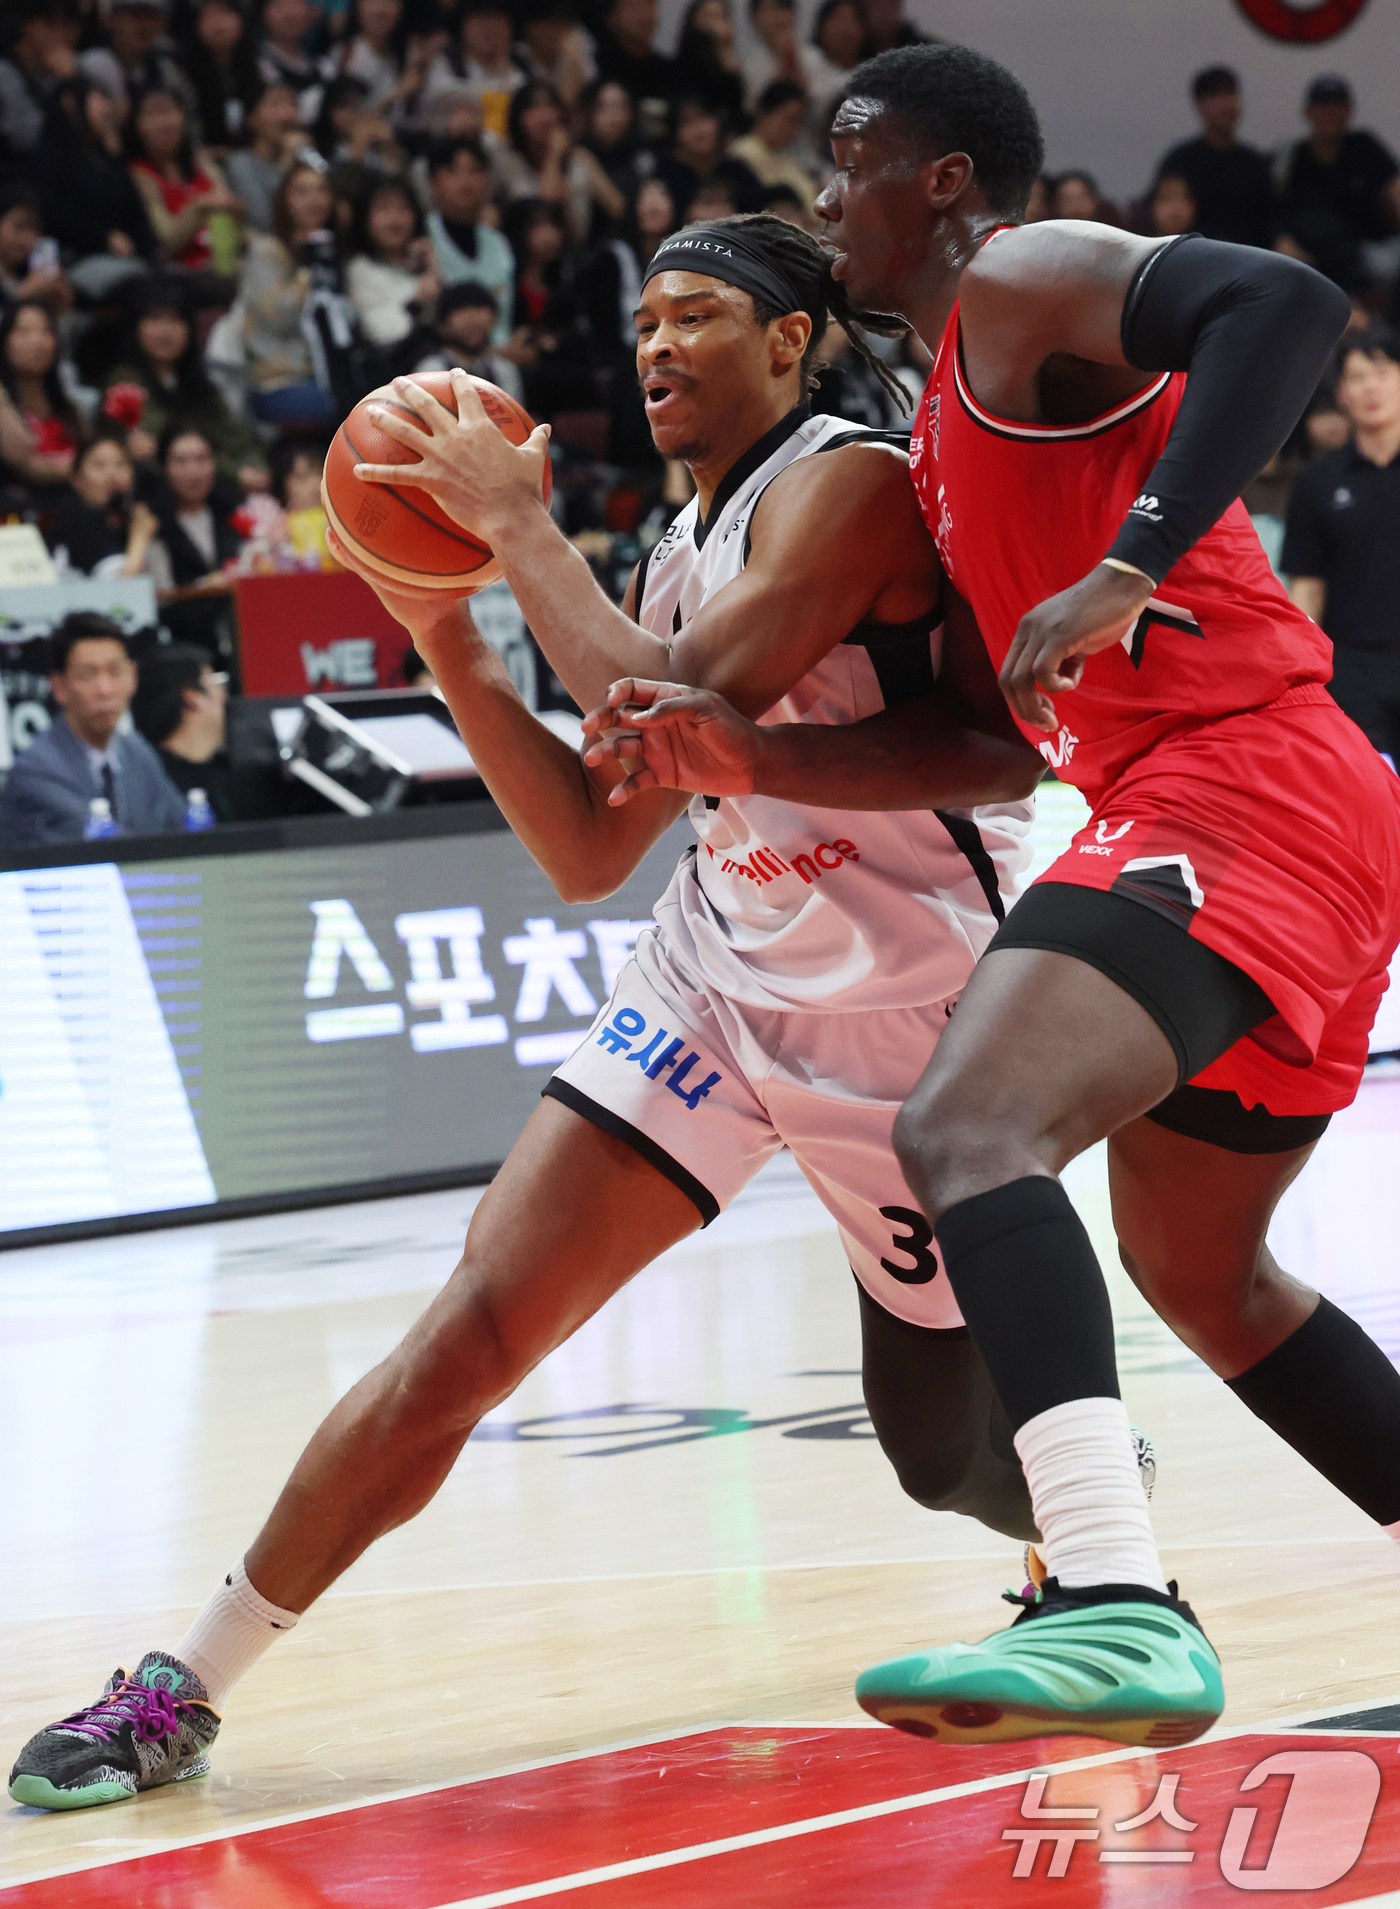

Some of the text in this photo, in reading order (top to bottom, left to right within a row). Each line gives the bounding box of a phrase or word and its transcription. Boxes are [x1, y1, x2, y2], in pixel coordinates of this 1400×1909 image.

[1078, 844, 1115, 857] VEXX
[596, 1007, 723, 1111] 유사나
[878, 1205, 938, 1285] 3
